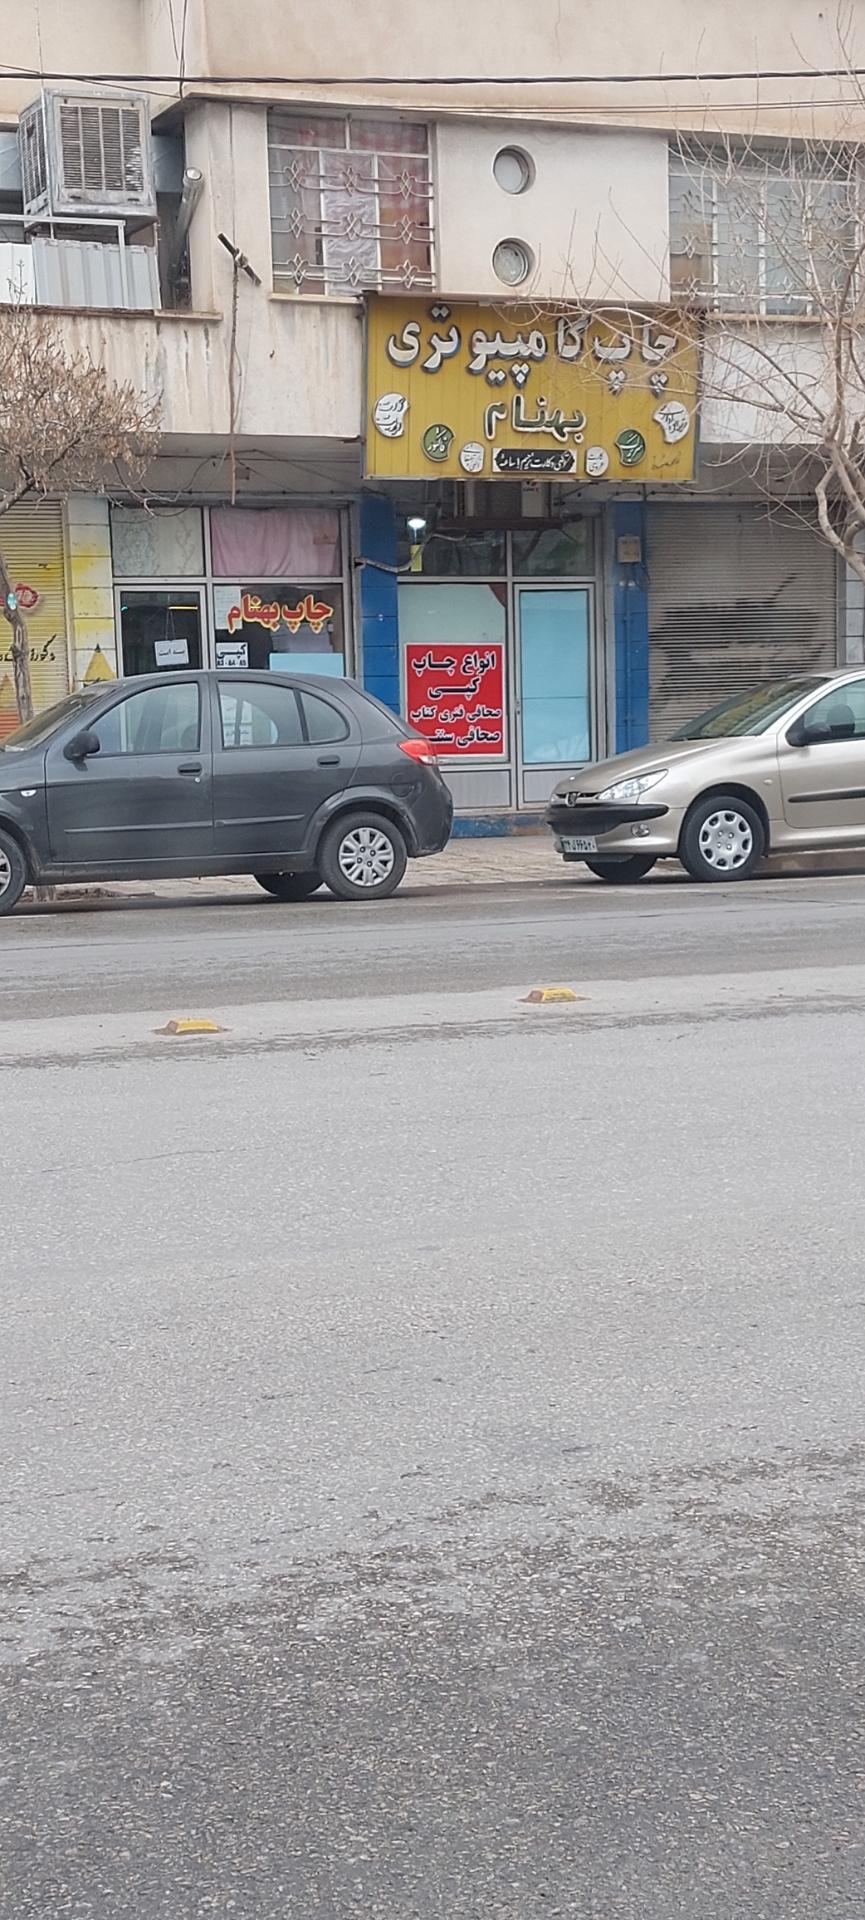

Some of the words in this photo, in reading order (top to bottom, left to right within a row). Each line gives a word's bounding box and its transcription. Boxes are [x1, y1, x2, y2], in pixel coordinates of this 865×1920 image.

[592, 321, 679, 398] چاپ
[484, 394, 586, 444] بهنام
[426, 426, 449, 452] فاکتور
[226, 594, 281, 635] بهنام
[281, 594, 334, 634] چاپ
[216, 643, 247, 659] کپی
[411, 649, 456, 677] چاپ
[461, 650, 496, 676] انواع
[427, 675, 481, 700] کپی
[410, 705, 436, 723] کتاب
[439, 703, 465, 723] فنری
[466, 703, 502, 721] صحافی
[427, 728, 455, 743] سنت
[456, 725, 501, 748] صحافی
